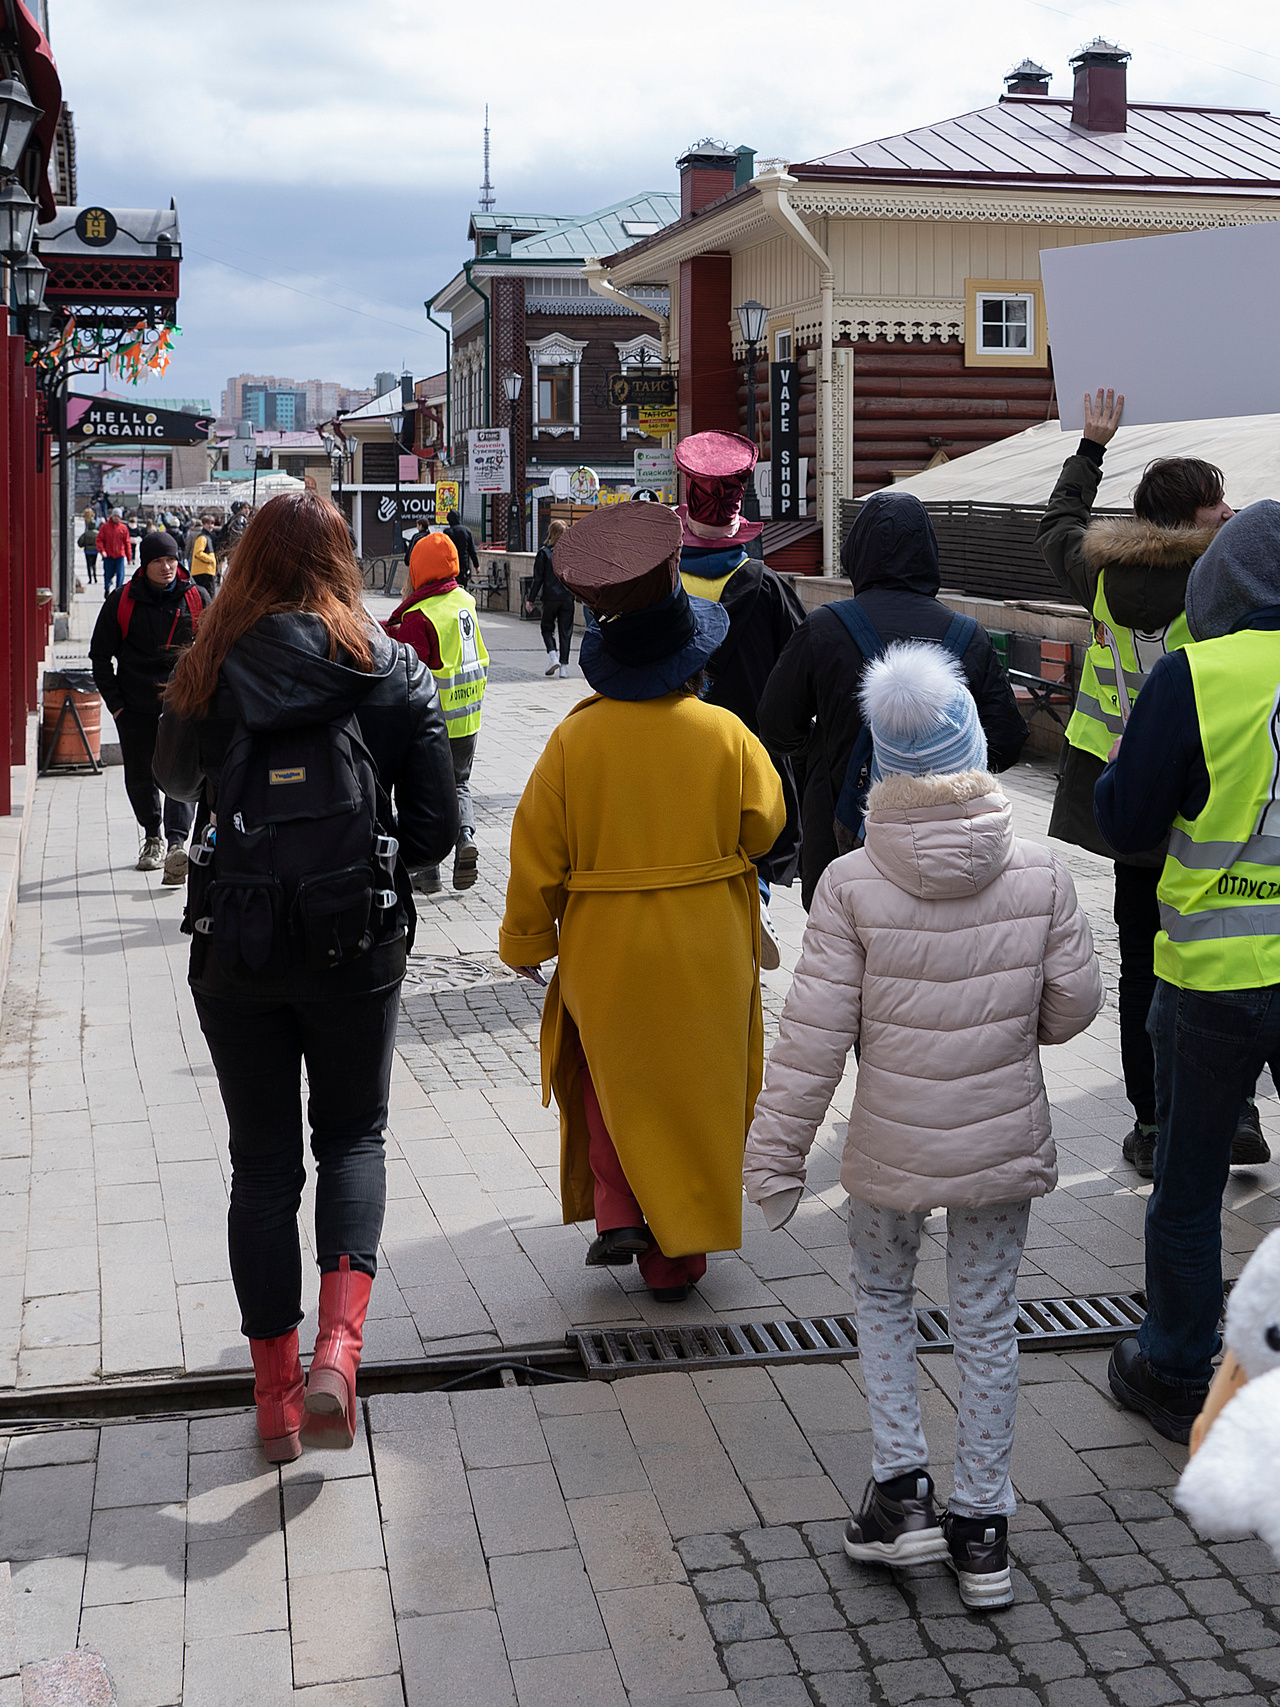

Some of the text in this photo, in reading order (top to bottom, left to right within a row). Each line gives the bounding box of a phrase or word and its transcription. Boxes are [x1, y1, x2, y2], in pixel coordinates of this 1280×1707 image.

[632, 381, 669, 392] ТАИС
[90, 411, 157, 424] HELLO
[82, 423, 164, 437] ORGANIC
[780, 369, 791, 513] VAPE SHOP
